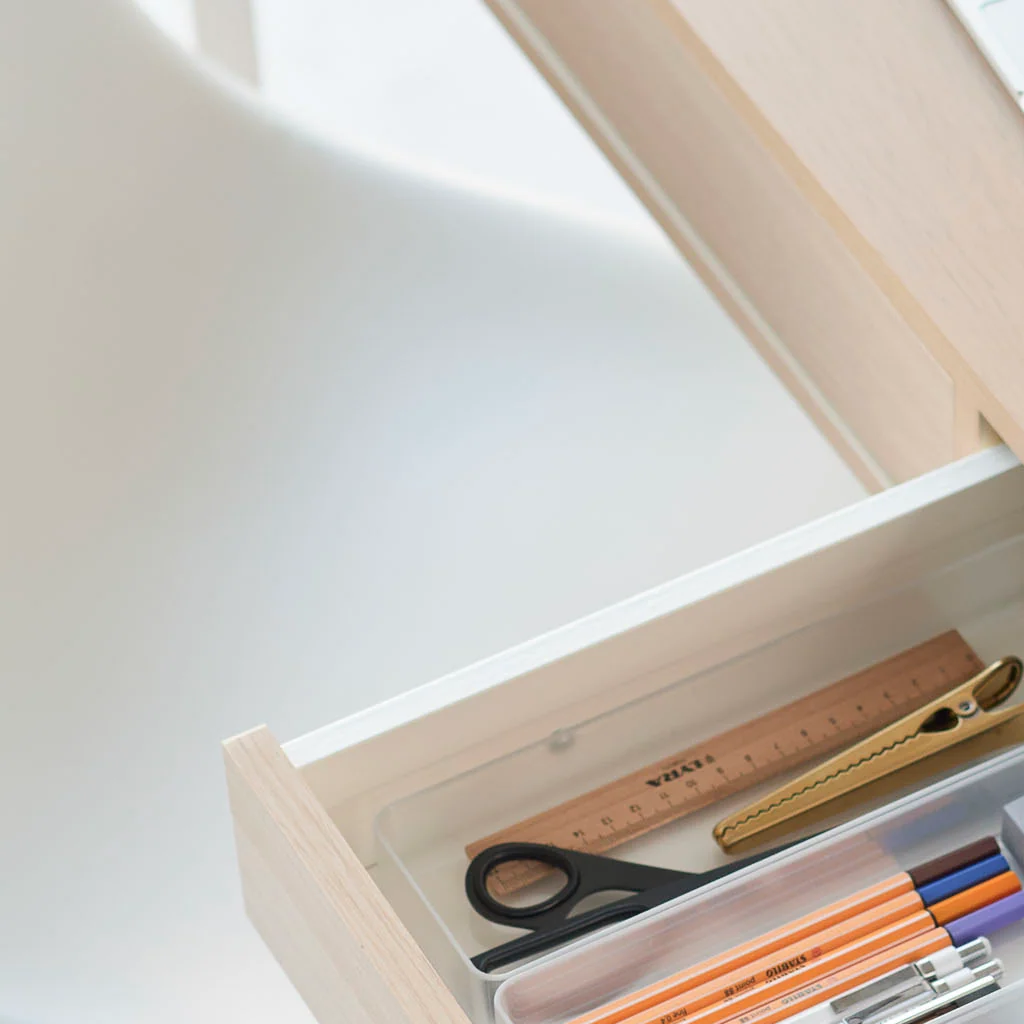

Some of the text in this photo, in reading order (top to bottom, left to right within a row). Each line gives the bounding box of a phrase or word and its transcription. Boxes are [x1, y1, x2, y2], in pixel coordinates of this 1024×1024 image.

[645, 759, 704, 787] LYRA
[765, 954, 807, 978] STABILO
[735, 976, 756, 993] point
[781, 984, 823, 1005] STABILO
